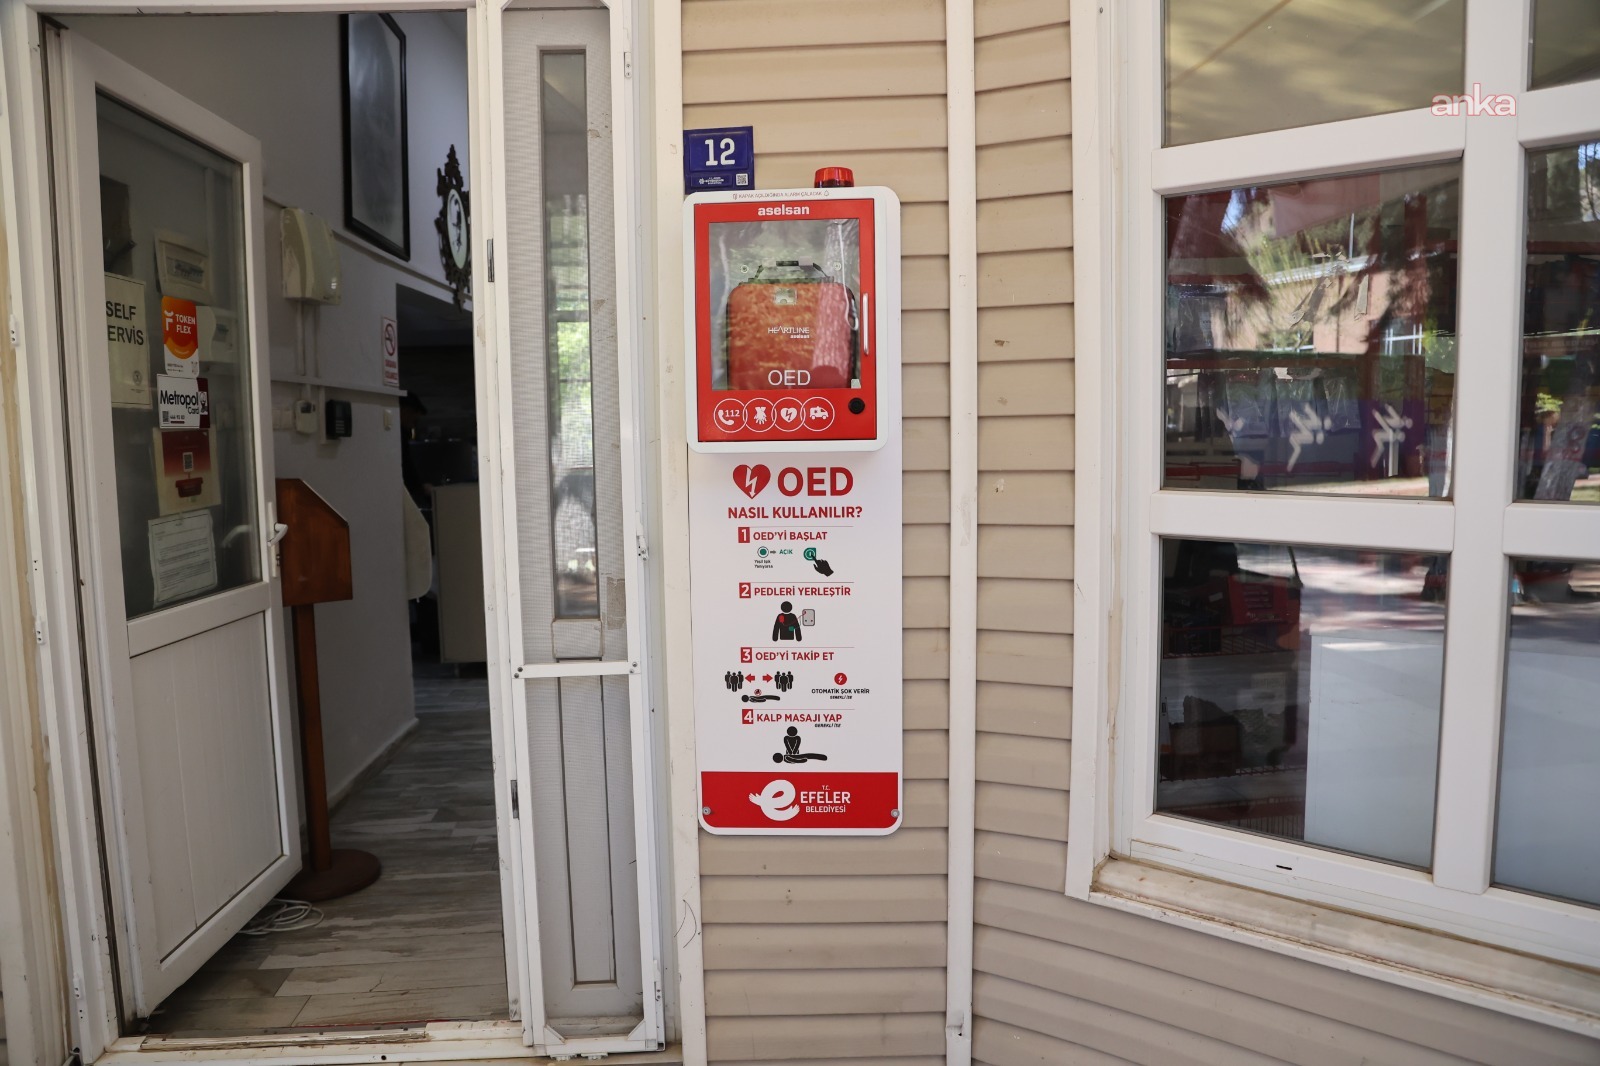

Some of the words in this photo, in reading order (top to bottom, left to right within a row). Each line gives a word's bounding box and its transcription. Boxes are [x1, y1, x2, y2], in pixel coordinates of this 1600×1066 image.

[704, 138, 736, 166] 12
[757, 203, 810, 216] aselsan
[105, 300, 136, 321] SELF
[175, 313, 196, 325] TOKEN
[107, 325, 144, 346] ERVİS
[176, 325, 192, 334] FLEX
[767, 325, 810, 334] HEARTLINE
[767, 369, 811, 386] OED
[160, 390, 199, 409] Metropol
[187, 407, 200, 415] Card
[724, 409, 740, 418] 112
[777, 466, 854, 497] OED
[728, 507, 769, 519] NASIL
[772, 506, 863, 519] KULLANILIR?
[741, 528, 748, 542] 1
[789, 531, 828, 542] BAŞLAT
[740, 585, 750, 597] 2
[754, 585, 796, 596] PEDLERİ
[798, 585, 851, 597] YERLEŞTİR
[742, 649, 751, 662] 3
[791, 650, 820, 661] TAKİP
[822, 651, 835, 661] ET
[744, 711, 753, 723] 4
[756, 713, 783, 722] KALP
[784, 713, 821, 722] MASAJI
[823, 713, 842, 722] YAP
[800, 791, 851, 804] EFELER
[805, 804, 846, 813] BELEDİYESİ
